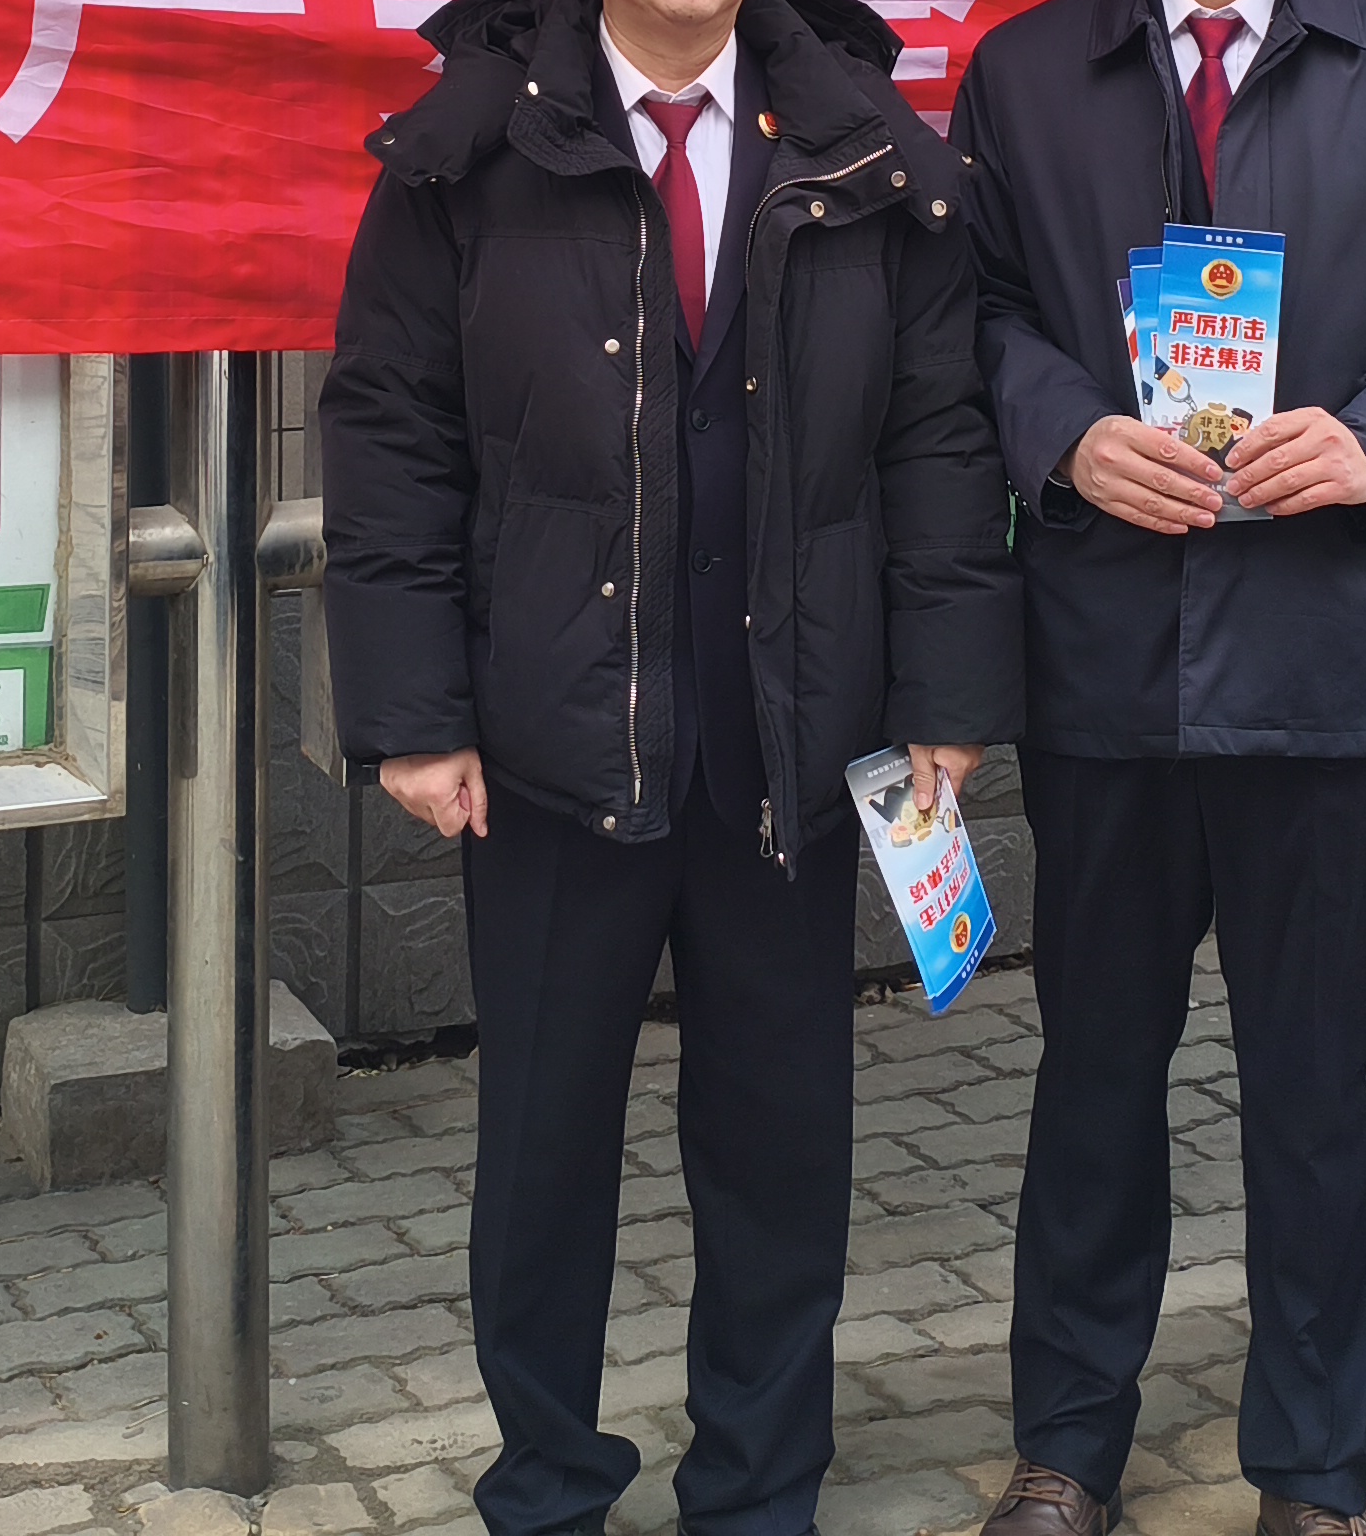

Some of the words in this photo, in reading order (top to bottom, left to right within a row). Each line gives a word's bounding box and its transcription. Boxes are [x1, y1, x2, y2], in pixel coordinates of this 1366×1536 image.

[1171, 311, 1266, 342] 严厉打击
[1169, 342, 1264, 373] 非法集资
